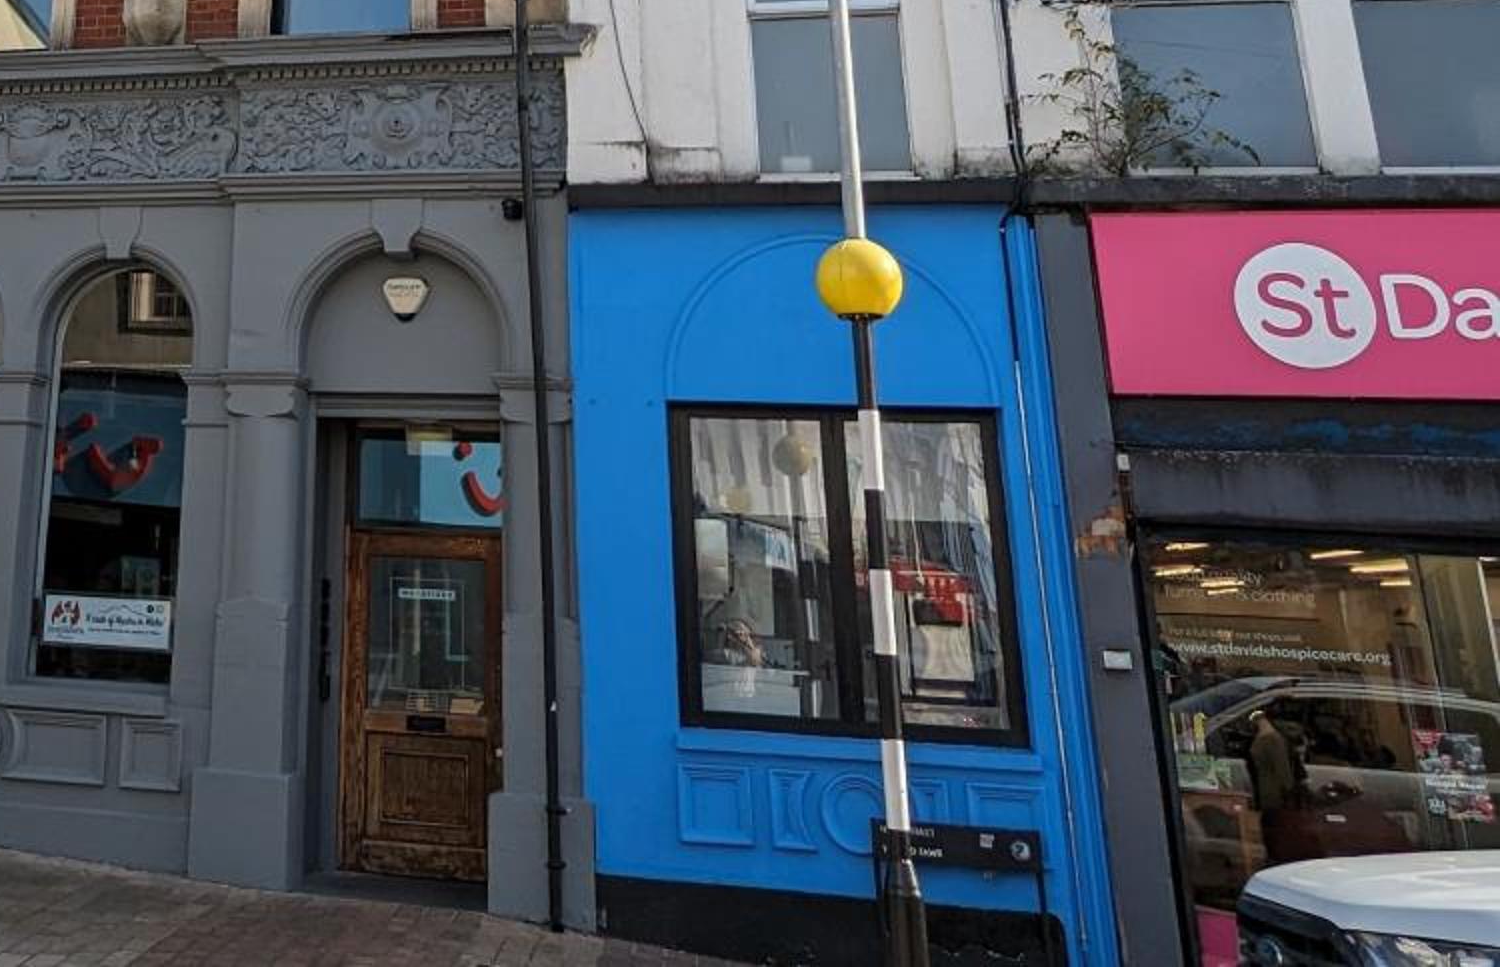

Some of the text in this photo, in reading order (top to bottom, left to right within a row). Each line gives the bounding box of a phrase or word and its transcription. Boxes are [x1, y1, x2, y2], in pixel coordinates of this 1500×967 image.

[1257, 273, 1500, 340] St Da
[1166, 640, 1391, 665] www.stdavidshospicecare.org
